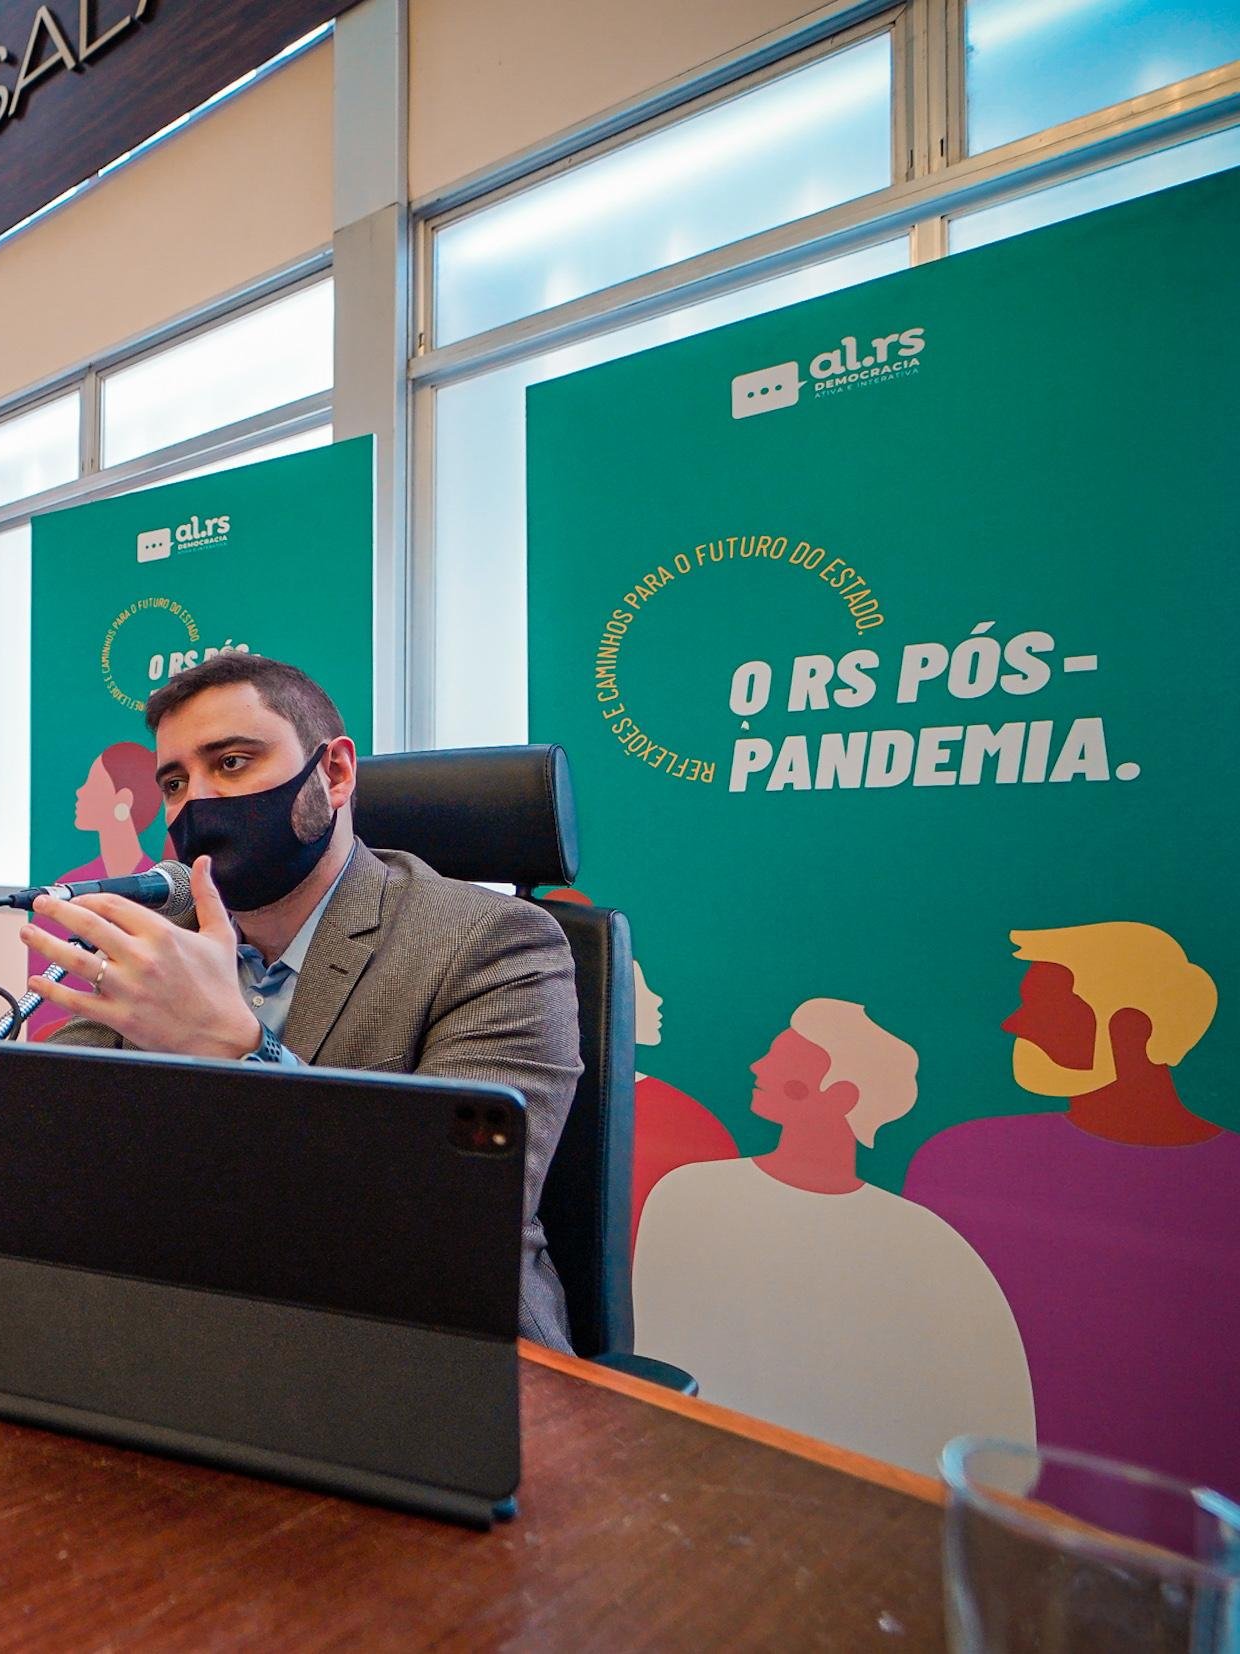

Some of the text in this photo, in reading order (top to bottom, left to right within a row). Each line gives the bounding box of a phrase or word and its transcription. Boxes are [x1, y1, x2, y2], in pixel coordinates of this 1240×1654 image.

[809, 327, 925, 379] al.rs
[814, 358, 920, 392] DEMOCRACIA
[175, 515, 230, 542] al.rs
[177, 535, 228, 550] DEMOCRACIA
[102, 629, 116, 673] CAMINHOS
[112, 609, 131, 630] PARA
[130, 604, 137, 614] O
[138, 597, 170, 611] FUTURO
[170, 602, 182, 615] DO
[595, 535, 884, 783] REFLEXÕES E CAMINHOS PARA O FUTURO DO ESTADO.
[149, 653, 164, 680] O
[168, 650, 198, 679] RS
[729, 620, 1098, 717] O RS PÓS-
[728, 717, 1141, 792] PANDEMIA.
